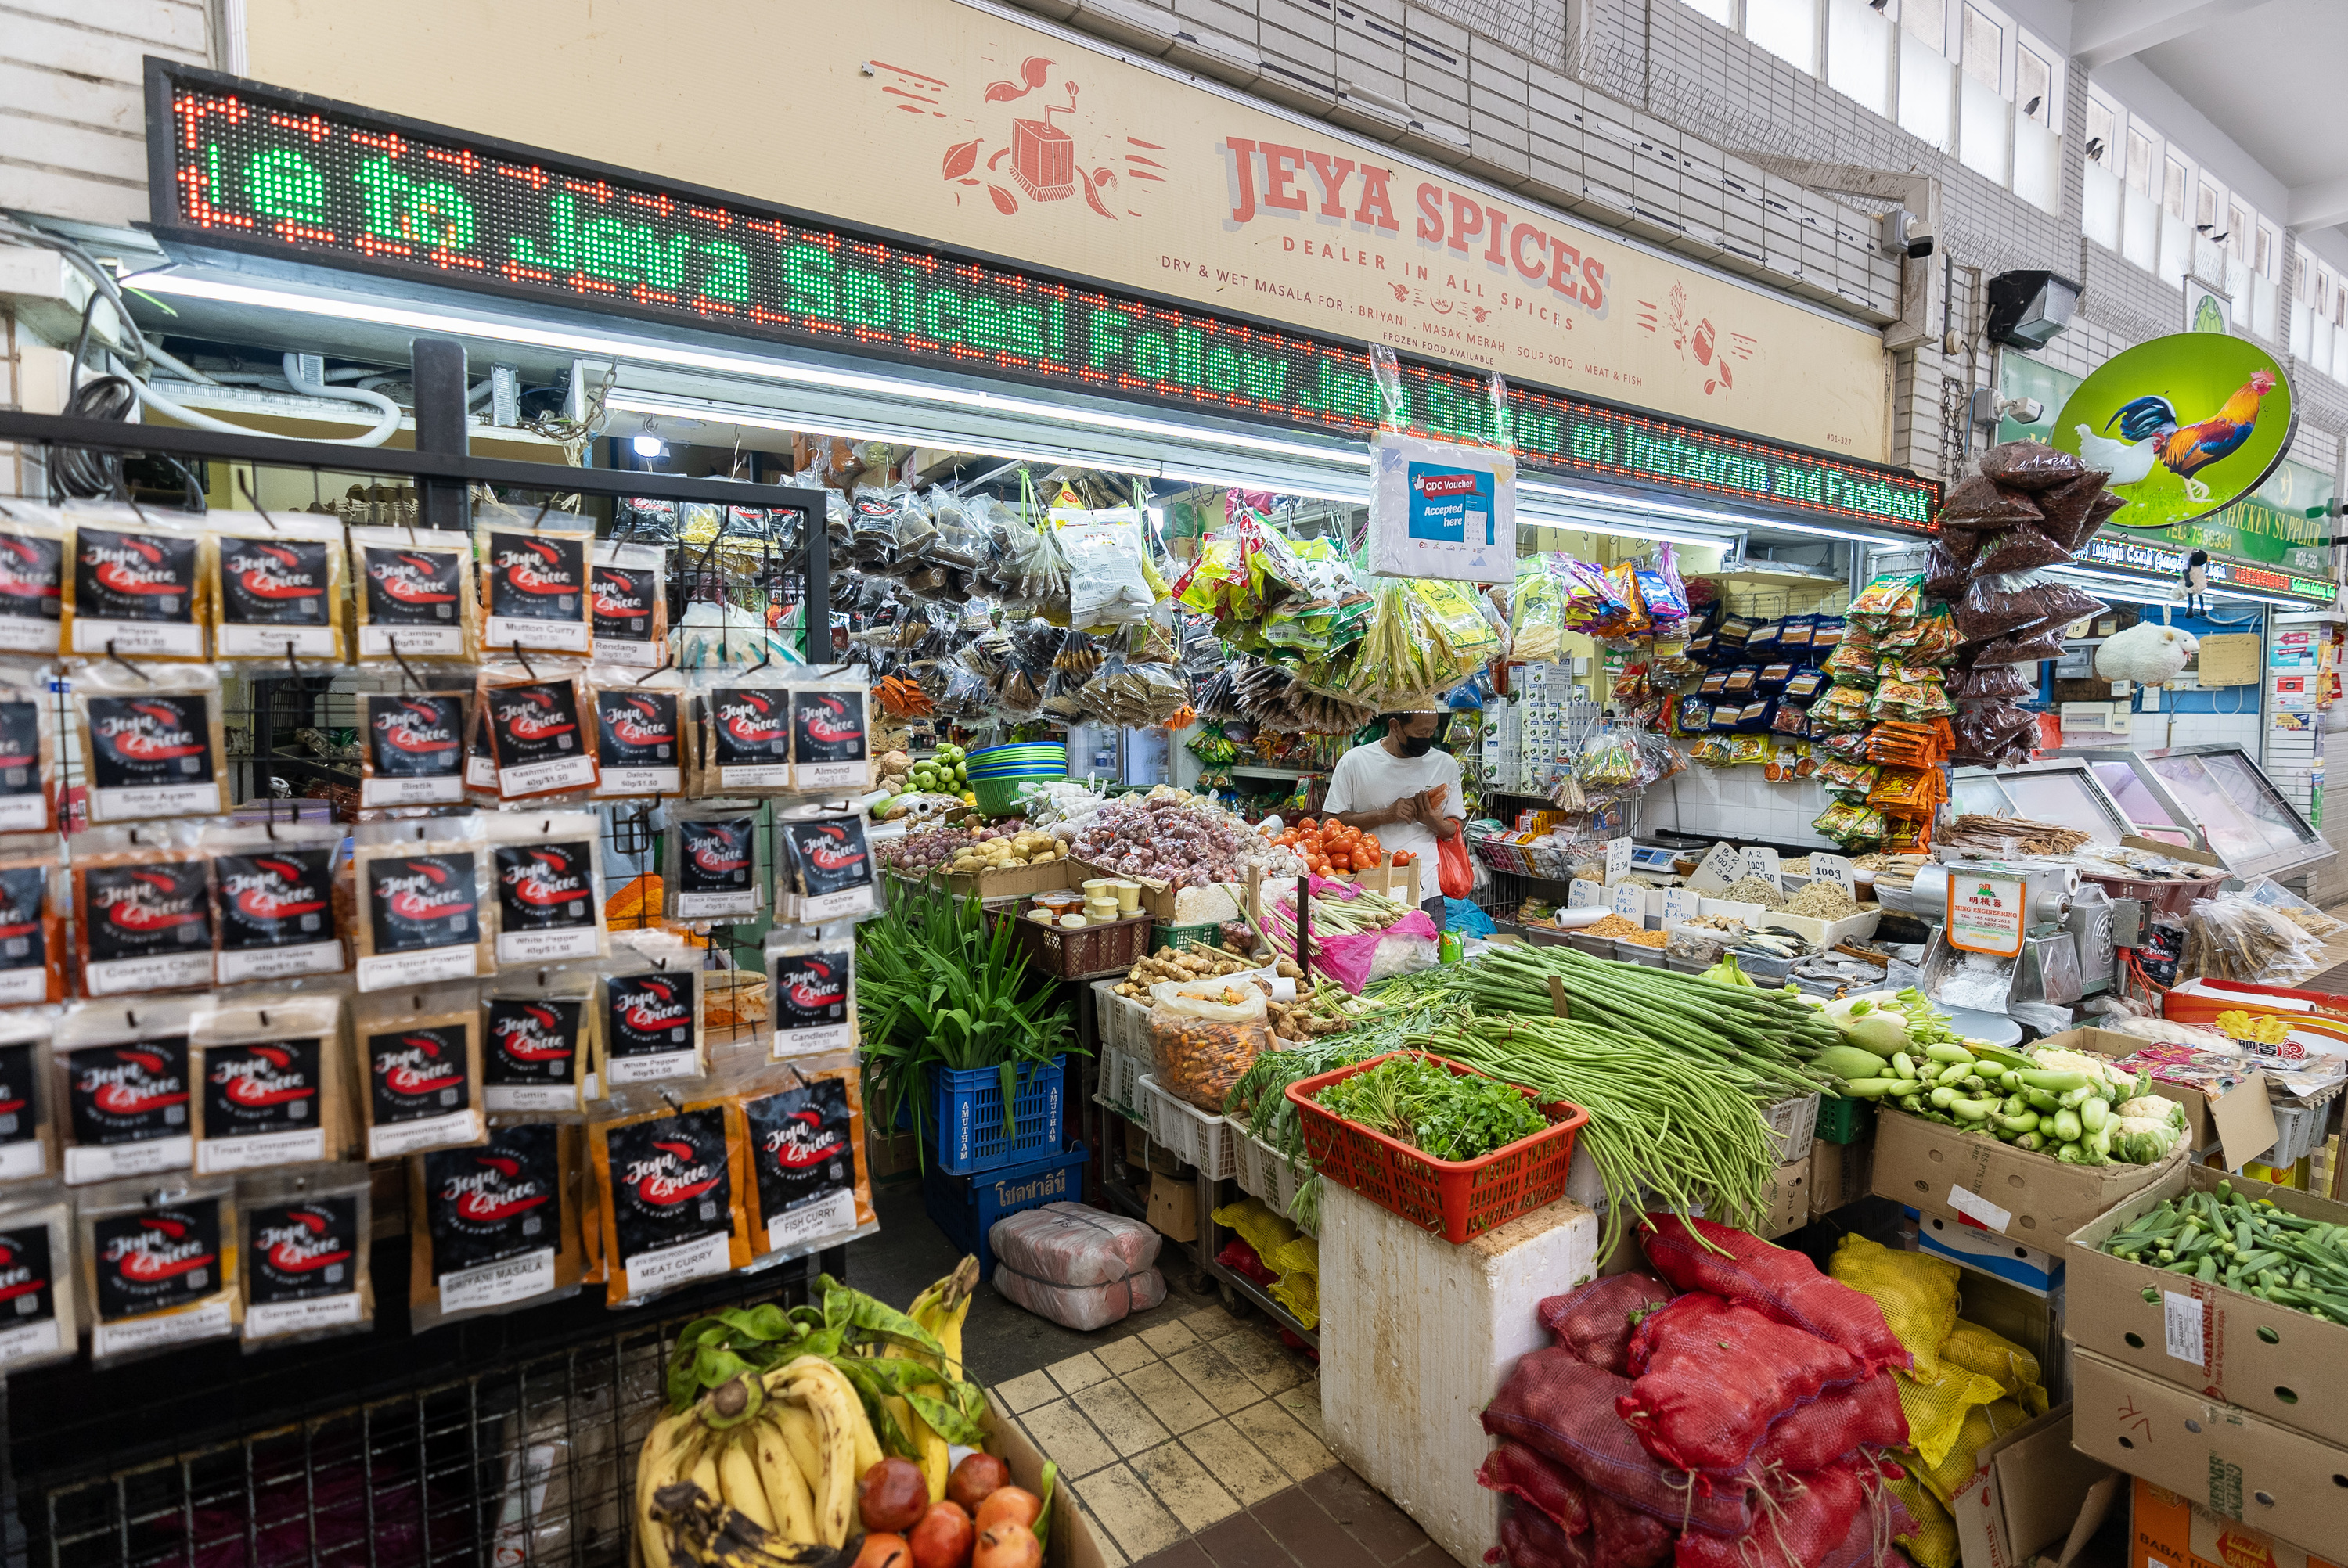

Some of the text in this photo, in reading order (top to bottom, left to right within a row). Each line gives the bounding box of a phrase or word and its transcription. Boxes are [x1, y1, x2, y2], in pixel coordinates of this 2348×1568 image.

[1221, 136, 1606, 312] JEYA SPICES
[1283, 236, 1573, 330] DEALER IN ALL SPICES
[1161, 255, 1642, 387] DRY & WET MASALA FOR BRIYANI MASAK MERAH SOUP SOTO MEAT & FISH
[1383, 331, 1494, 365] FROZEN FOOD AVAILABLE
[1093, 309, 1288, 401] Follow
[1571, 423, 1615, 465] on
[1624, 423, 1770, 494] Instagram
[1774, 462, 1822, 505] and
[1827, 470, 1931, 523] Facebook
[1826, 433, 1853, 447] #01-327
[1425, 479, 1473, 491] CDC Voucher
[1424, 503, 1463, 517] Accepted
[1443, 516, 1463, 527] here
[2217, 507, 2321, 548] CHICKEN SUPPLIER
[2191, 526, 2232, 550] 7558334
[2295, 551, 2318, 569] #01-329
[505, 622, 577, 636] Mutton Curry
[595, 641, 638, 653] Rendang
[556, 761, 578, 773] Chilli
[814, 766, 850, 775] Almond
[1713, 854, 1734, 872] 100g
[1815, 867, 1841, 879] 100g
[823, 895, 854, 905] Cashew
[1616, 897, 1632, 906] 100g
[1666, 902, 1682, 912] 100g
[1973, 907, 2018, 919] ENGINEERING
[791, 1029, 838, 1042] Candlenut
[622, 1060, 647, 1069] White
[766, 1121, 809, 1152] Jeya
[960, 1102, 969, 1160] AMUTHAM
[787, 1131, 834, 1162] Spices
[627, 1153, 675, 1185] Jeya
[1977, 1164, 1987, 1179] PTE
[784, 1218, 803, 1233] FISH
[806, 1207, 837, 1224] CURRY
[641, 1263, 672, 1278] MEAT
[675, 1250, 714, 1270] CURRY
